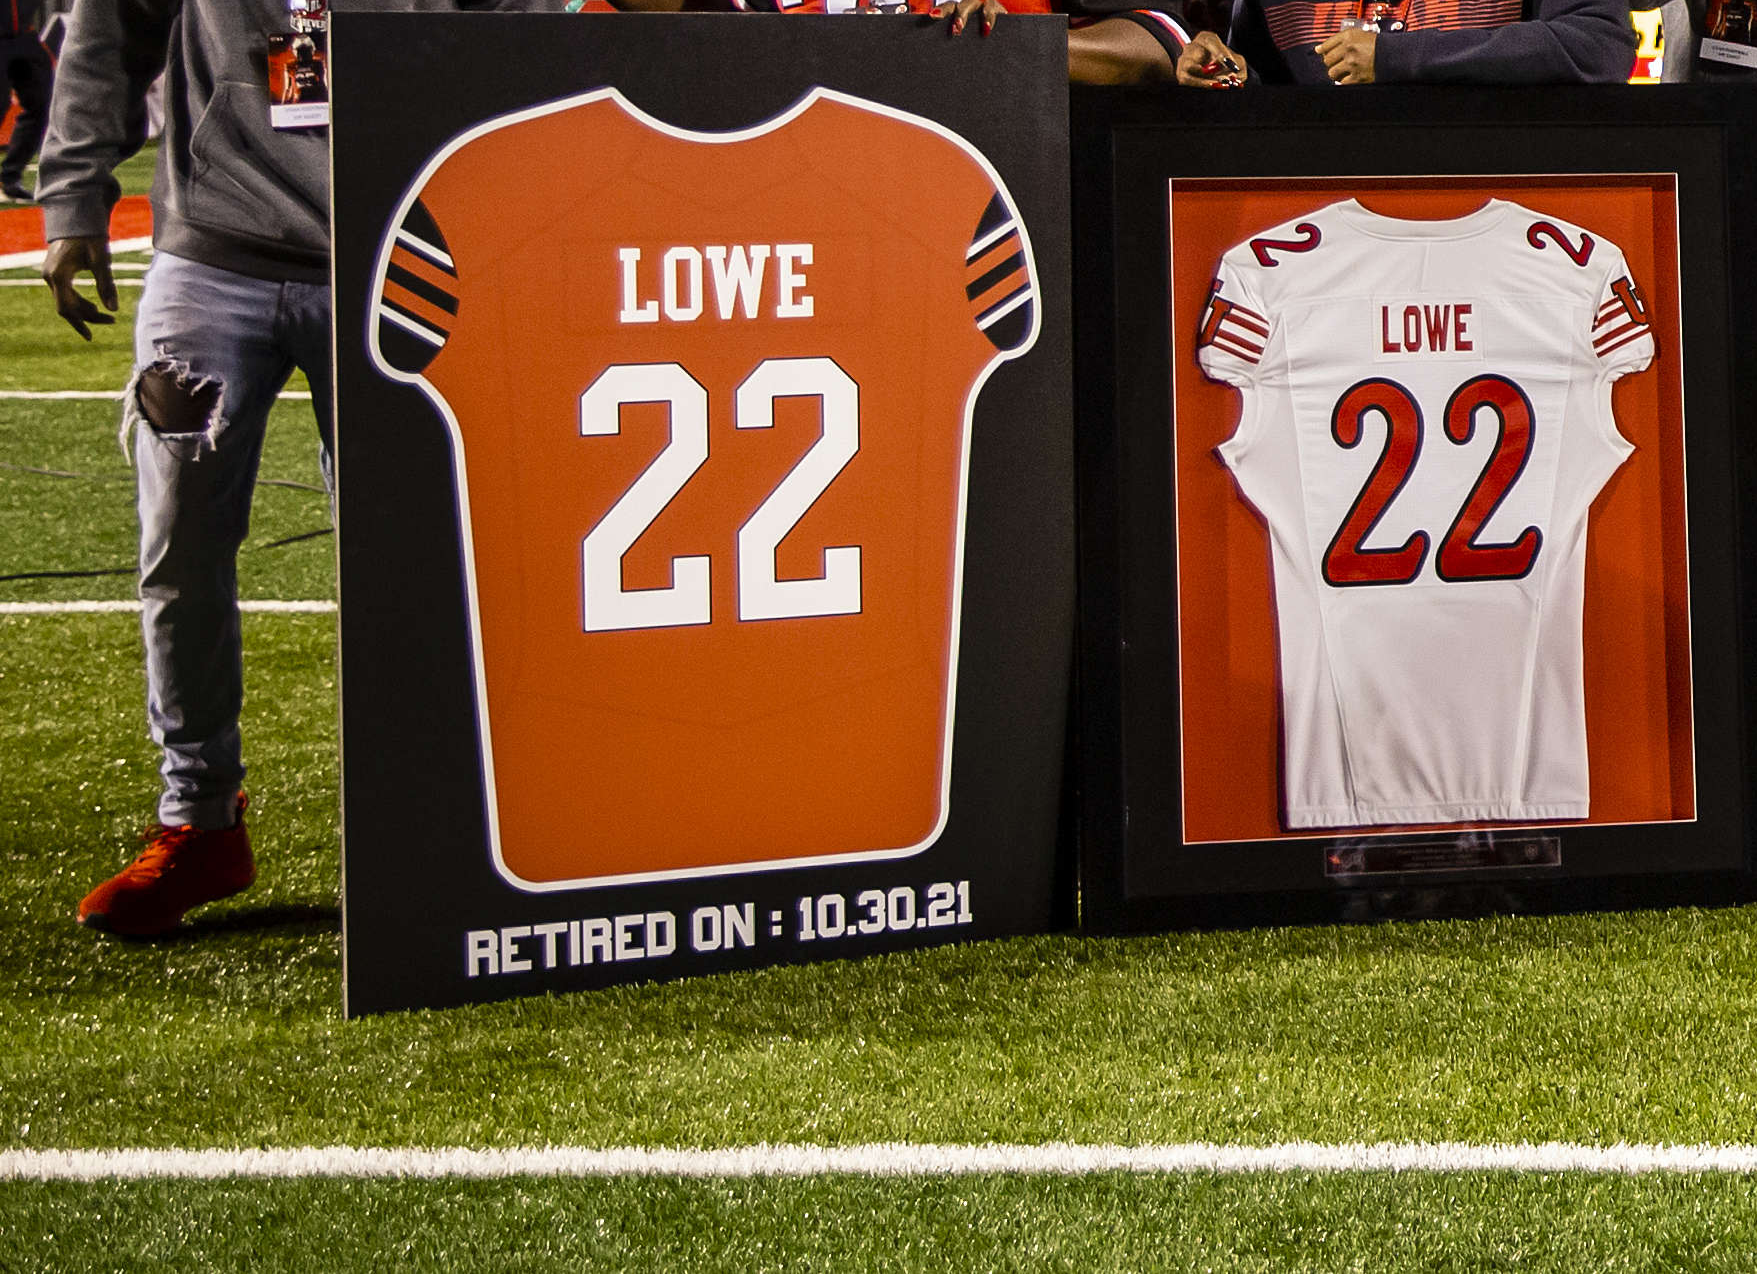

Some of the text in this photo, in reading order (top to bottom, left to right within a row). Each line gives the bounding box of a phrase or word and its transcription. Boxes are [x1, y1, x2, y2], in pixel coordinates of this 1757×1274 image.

[619, 244, 815, 324] LOWE
[1380, 303, 1473, 354] LOWE
[579, 355, 864, 634] 22
[1321, 372, 1545, 589] 22
[466, 910, 676, 978] RETIRED
[692, 900, 756, 954] ON
[798, 880, 974, 943] 10.30.21
